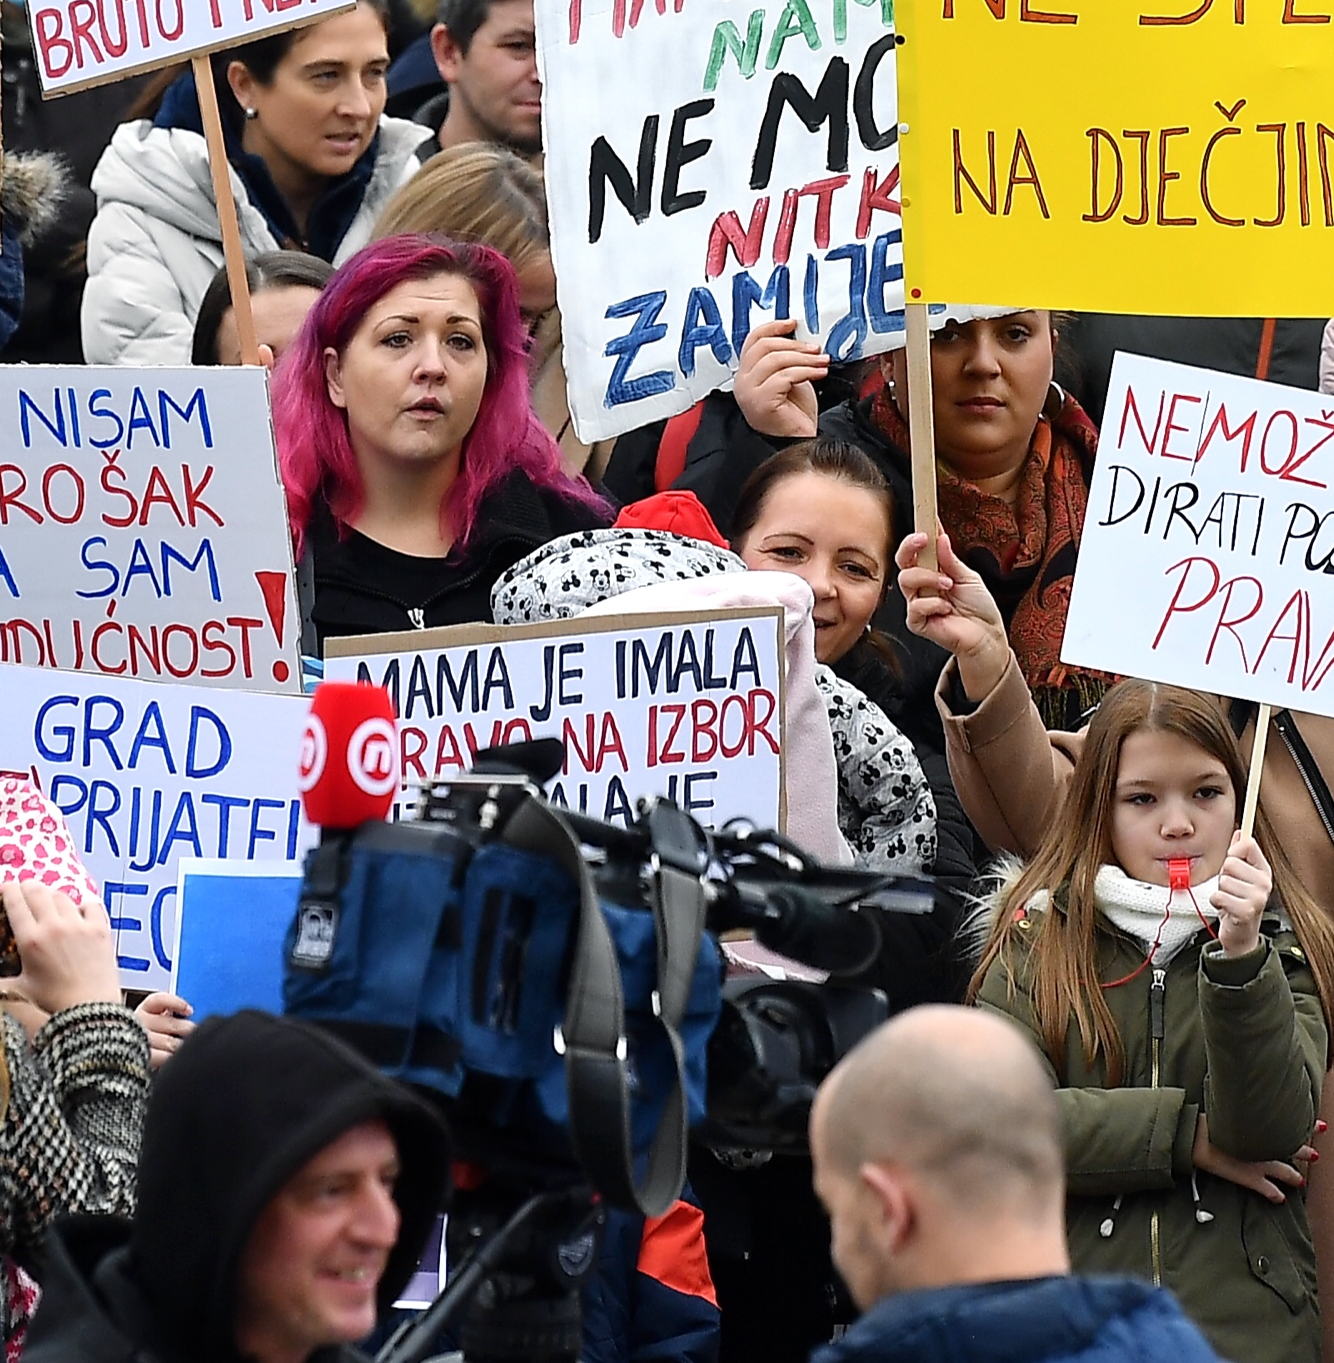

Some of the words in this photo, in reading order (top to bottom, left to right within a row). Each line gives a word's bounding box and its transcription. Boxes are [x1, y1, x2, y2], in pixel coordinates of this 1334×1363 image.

[588, 98, 715, 244] NE
[953, 128, 1049, 219] NA
[19, 386, 214, 449] NISAM
[1099, 465, 1264, 556] DIRATI
[75, 536, 222, 603] SAM
[530, 642, 585, 722] JE
[616, 626, 762, 700] IMALA
[34, 695, 233, 778] GRAD
[563, 711, 628, 775] NA
[646, 688, 780, 768] IZBOR
